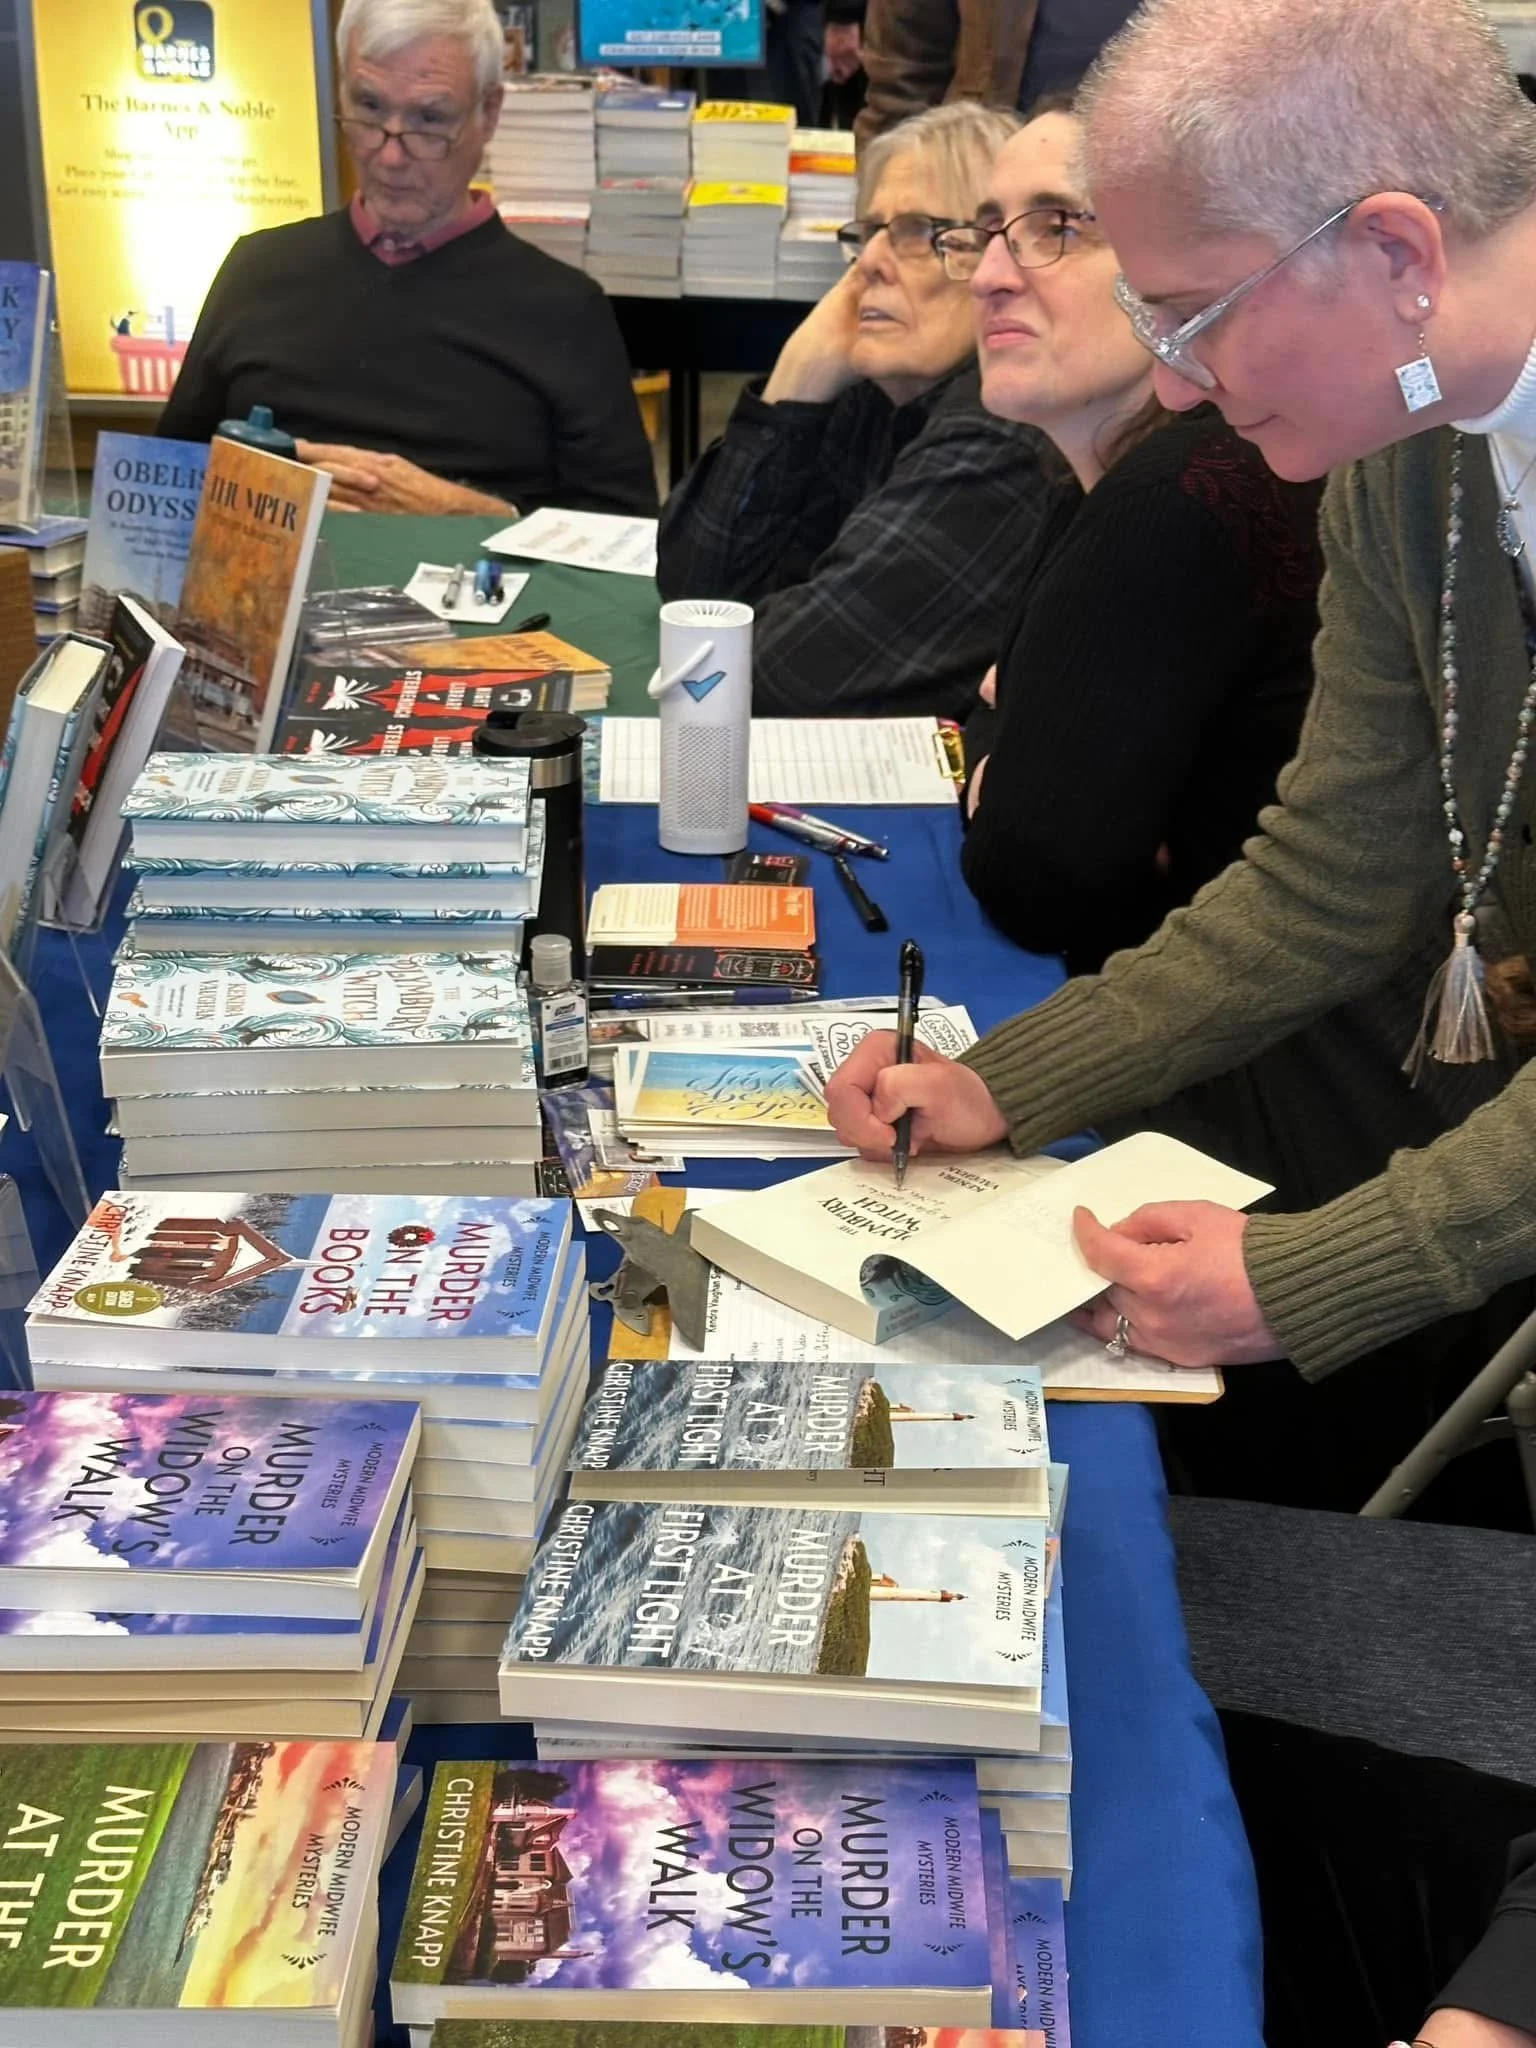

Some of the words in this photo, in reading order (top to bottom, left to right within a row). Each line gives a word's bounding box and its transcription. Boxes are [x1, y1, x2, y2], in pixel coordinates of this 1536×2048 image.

[81, 93, 122, 112] The
[219, 99, 276, 120] Noble
[113, 458, 206, 491] OBELI
[342, 969, 383, 1023] WITCH
[386, 960, 436, 1034] PLYMBURY
[70, 1203, 129, 1267] CHRISTINE
[853, 1196, 921, 1232] WITCH
[299, 1227, 371, 1316] BOOKS
[383, 1225, 437, 1266] ON
[426, 1221, 496, 1323] MURDER
[502, 1245, 524, 1288] MYSTERIES
[533, 1231, 553, 1266] MODERN
[45, 1267, 88, 1310] KNAPP
[363, 1273, 419, 1317] THE
[522, 1266, 544, 1302] MIDWIFE
[708, 1280, 722, 1308] Vaughan
[705, 1309, 718, 1333] Kendra
[593, 1362, 635, 1427] CHRISTINE
[688, 1364, 735, 1414] FIRST
[744, 1400, 786, 1427] AT
[802, 1374, 850, 1455] MURDER
[1003, 1399, 1017, 1432] MYSTERIES
[1024, 1389, 1038, 1415] MODERN
[580, 1426, 618, 1470] KNAPP
[677, 1412, 727, 1466] LIGHT
[1028, 1415, 1042, 1443] MIDWIFE
[52, 1436, 141, 1522] WALK
[111, 1410, 225, 1554] WIDOW'S
[213, 1446, 252, 1476] ON
[228, 1422, 322, 1546] MURDER
[320, 1458, 353, 1509] MYSTERIES
[355, 1441, 384, 1485] MODERN
[194, 1482, 237, 1516] THE
[339, 1484, 371, 1528] MIDWIFE
[541, 1504, 596, 1592] CHRISTINE
[647, 1510, 705, 1574] FIRST
[707, 1562, 756, 1600] AT
[768, 1528, 832, 1648] MURDER
[995, 1571, 1013, 1622] MYSTERIES
[1025, 1556, 1039, 1597] MODERN
[520, 1593, 562, 1658] KNAPP
[626, 1574, 686, 1659] LIGHT
[1020, 1597, 1037, 1642] MIDWIFE
[2, 1802, 65, 1858] AT
[333, 1806, 364, 1870] MODERN
[426, 1777, 475, 1888] CHRISTINE
[791, 1827, 823, 1866] ON
[943, 1816, 962, 1870] MODERN
[42, 1785, 156, 1969] MURDER
[291, 1833, 324, 1909] MYSTERIES
[645, 1820, 703, 1932] WALK
[721, 1781, 778, 1971] WIDOW'S
[791, 1875, 823, 1919] THE
[840, 1794, 891, 1957] MURDER
[916, 1839, 936, 1906] MYSTERIES
[317, 1873, 348, 1937] MIDWIFE
[946, 1875, 967, 1929] MIDWIFE
[410, 1894, 454, 1969] KNAPP
[1036, 1938, 1054, 1996] MODERN
[1040, 1999, 1057, 2047] MIDWI
